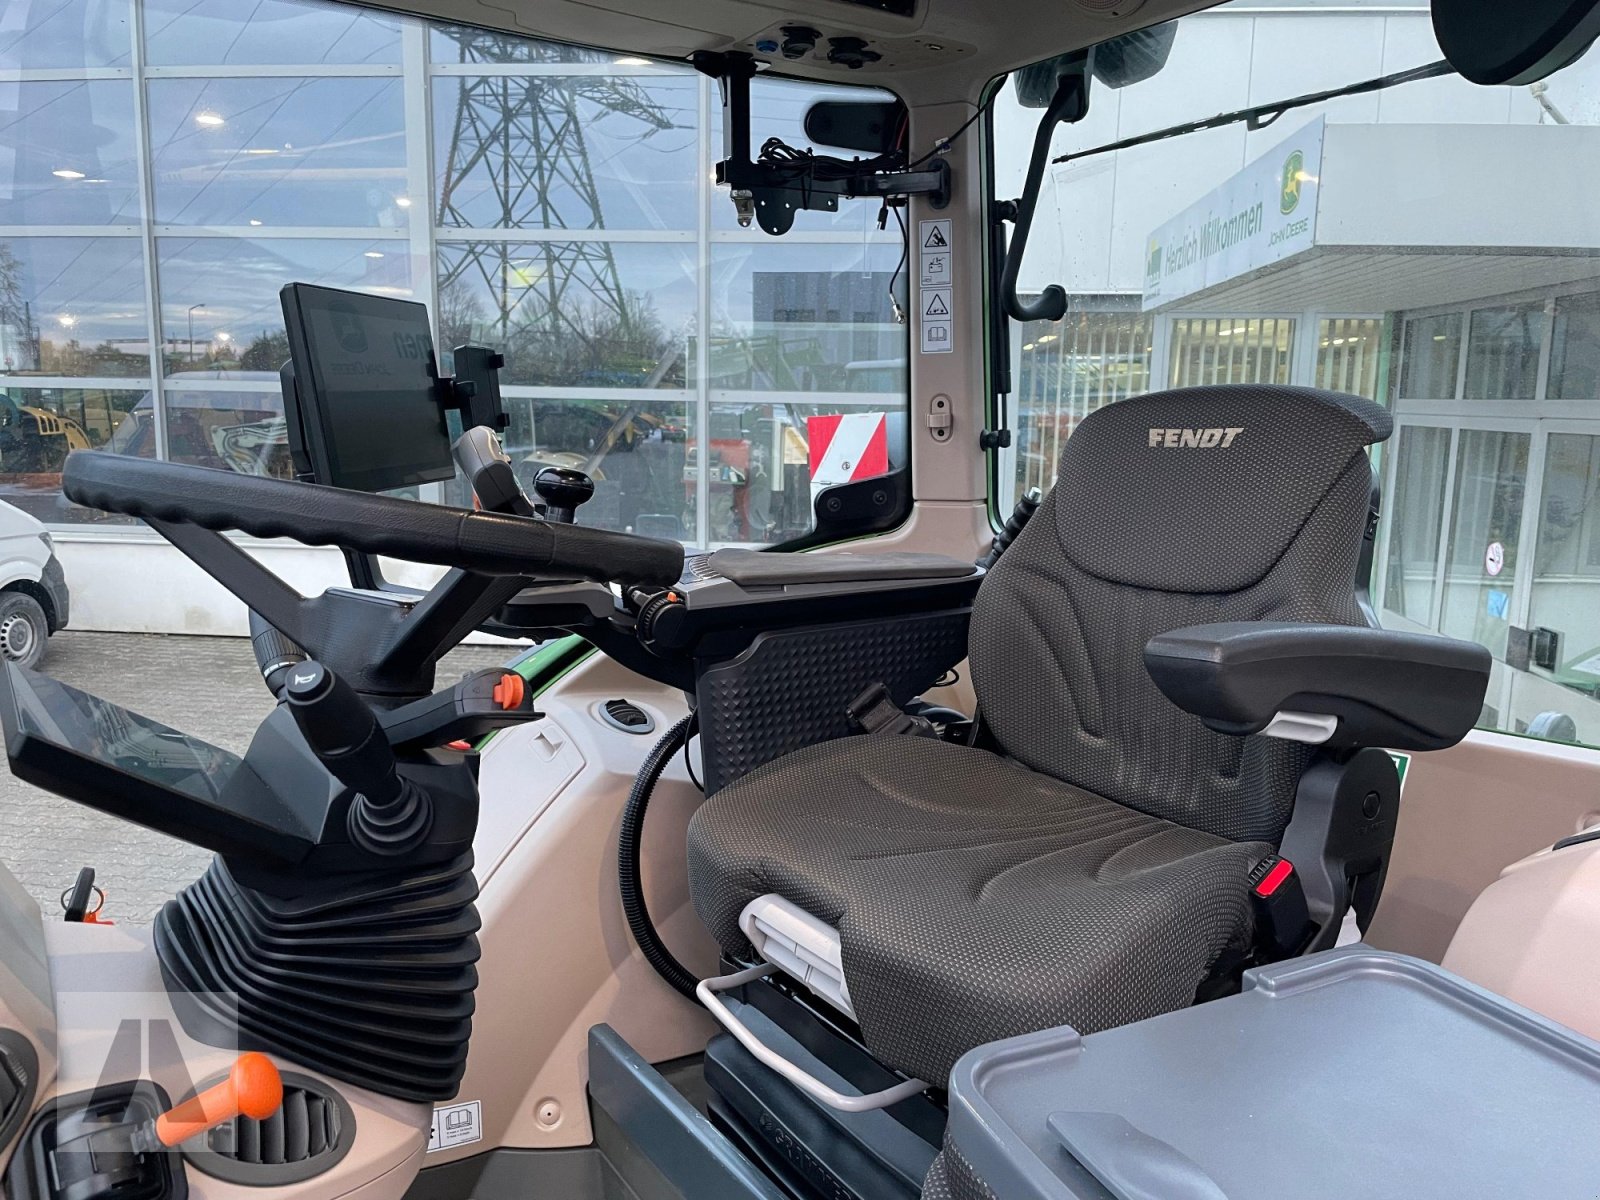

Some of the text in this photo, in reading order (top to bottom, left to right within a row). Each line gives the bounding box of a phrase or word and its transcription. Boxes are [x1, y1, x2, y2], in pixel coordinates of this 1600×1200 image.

[1164, 201, 1263, 277] Herzlich Willkommen
[1267, 217, 1309, 247] JOHN DEERE
[1148, 427, 1245, 448] FENDT
